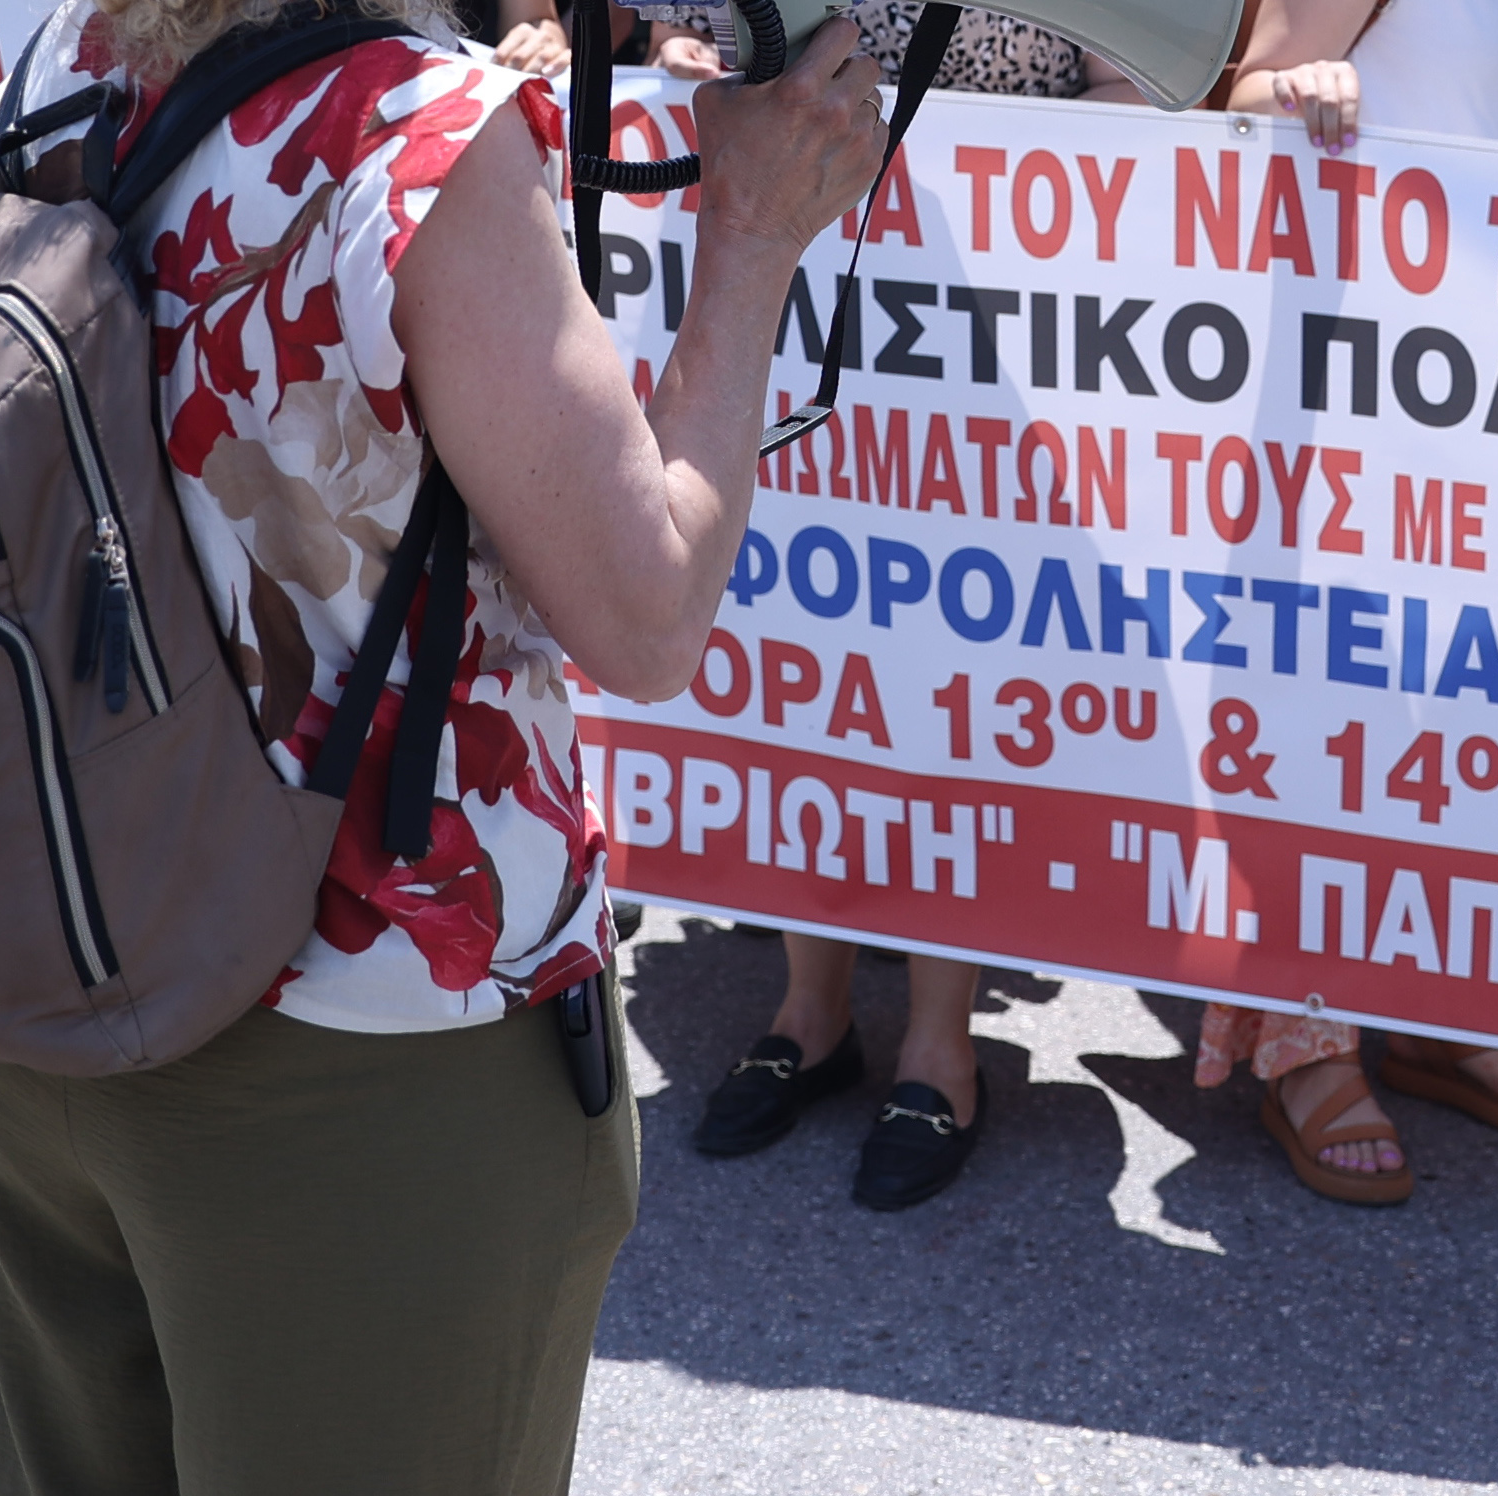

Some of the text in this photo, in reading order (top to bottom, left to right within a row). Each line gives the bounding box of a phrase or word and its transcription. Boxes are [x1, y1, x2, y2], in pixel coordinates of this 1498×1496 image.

[955, 145, 1135, 261] ΤΟΥ
[1174, 147, 1450, 295] ΝΑΤΟ
[564, 231, 1250, 403] ΡΙΛΙΣΤΙΚΟ
[758, 390, 1127, 530] ΙΩΜΑΤΩΝ
[1156, 432, 1364, 554] ΤΟΥΣ
[1393, 474, 1486, 571] ΜΕ
[1200, 698, 1277, 800] &
[581, 745, 1015, 900] ΒΡΙΩΤΗ"
[1111, 820, 1260, 942] "Μ.
